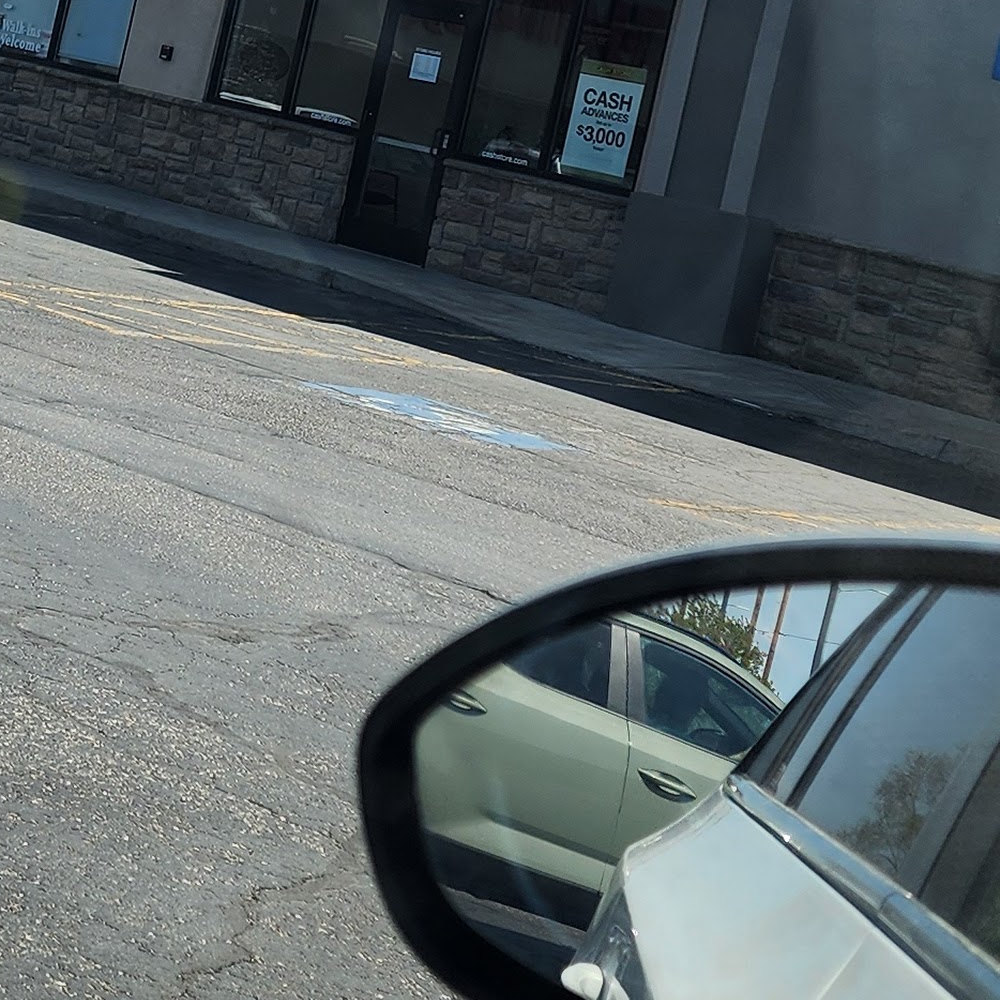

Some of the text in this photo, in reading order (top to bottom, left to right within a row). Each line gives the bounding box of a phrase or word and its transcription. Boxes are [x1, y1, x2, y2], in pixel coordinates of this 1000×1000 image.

[1, 18, 42, 39] Walk-ins
[583, 87, 634, 113] CASH
[580, 106, 630, 124] ADVANCES
[575, 124, 626, 148] $3,000
[481, 150, 529, 167] cashstore.com
